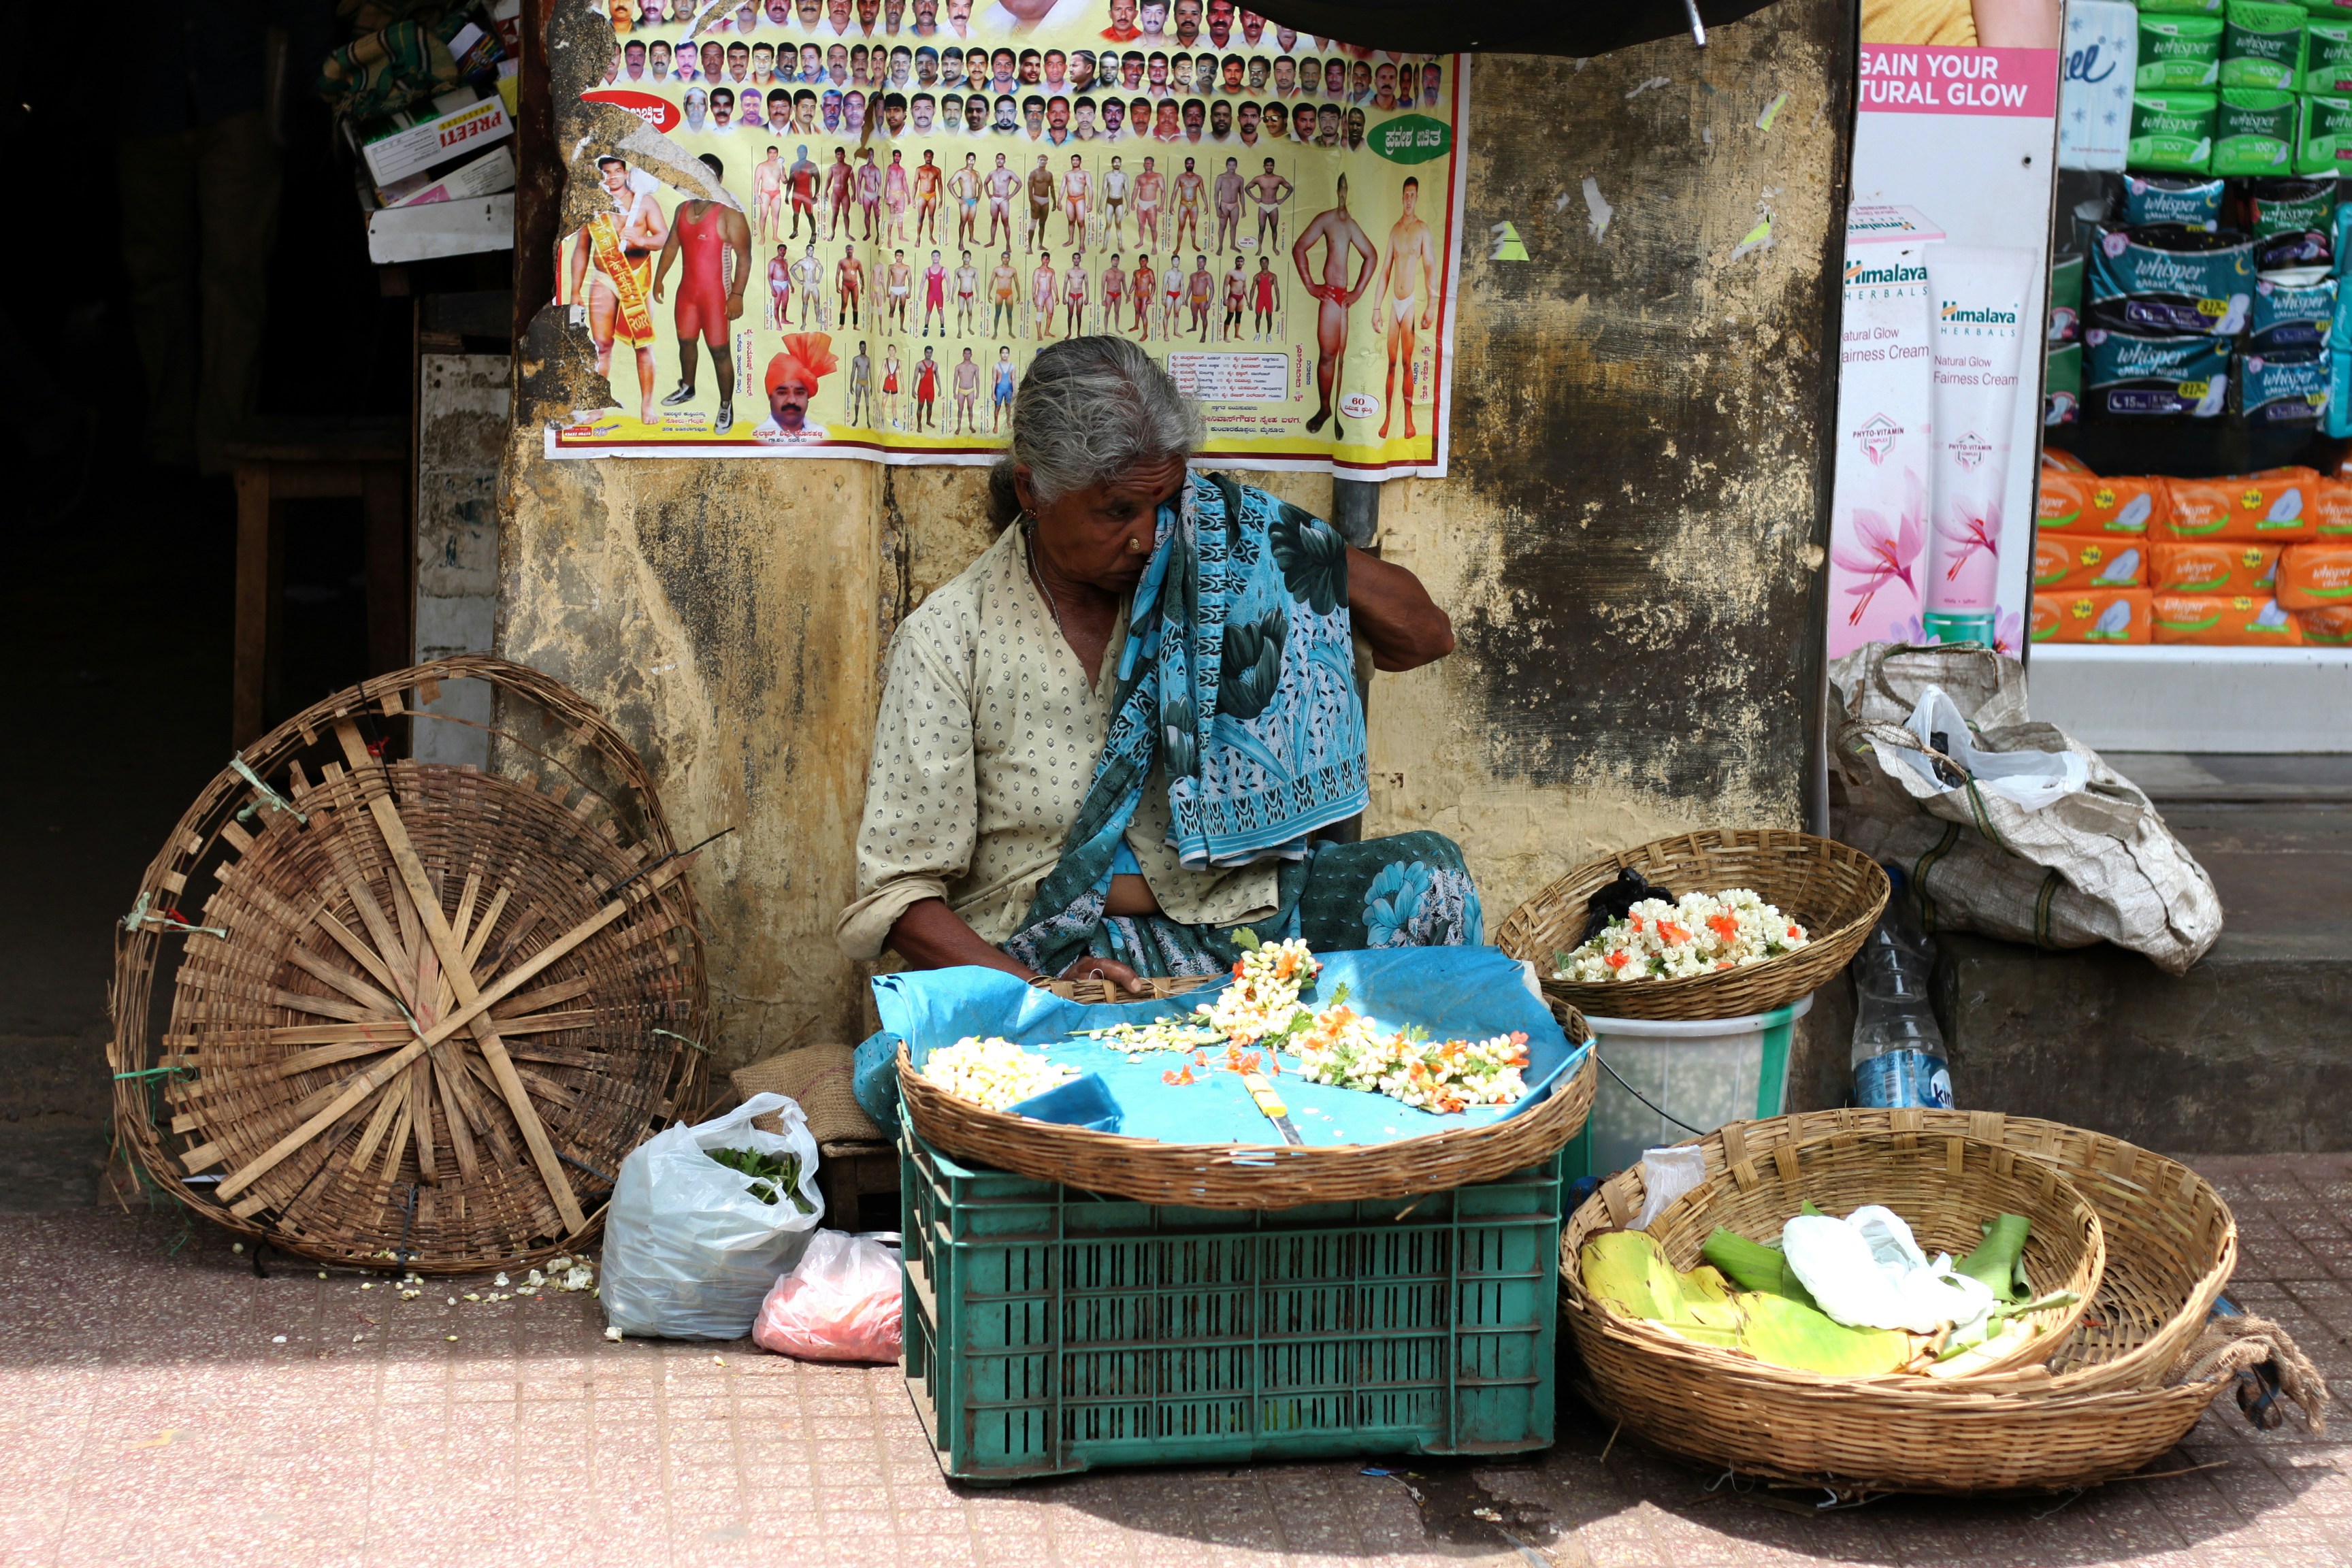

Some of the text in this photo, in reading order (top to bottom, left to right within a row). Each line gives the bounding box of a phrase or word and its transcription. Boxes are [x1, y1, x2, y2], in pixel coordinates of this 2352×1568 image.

[2153, 37, 2210, 58] whisper
[2236, 35, 2283, 54] whisper
[1861, 52, 1999, 80] GAIN YOUR
[1859, 80, 2028, 108] TURAL GLOW
[439, 110, 503, 148] PREETI
[2141, 113, 2198, 133] whisper
[2230, 111, 2276, 129] whisper
[1386, 126, 1414, 155] ಪ್ರವೇಶ
[2144, 193, 2198, 216] whisper
[1845, 260, 1928, 284] Himalaya
[2136, 255, 2204, 284] whisper
[1844, 287, 1928, 301] HERBALS
[2174, 282, 2208, 294] Nights
[1941, 300, 2016, 324] Himalaya
[2273, 292, 2325, 313] whisper
[1874, 327, 1899, 340] Glow
[1941, 327, 2015, 337] HERBALS
[1889, 344, 1929, 360] Cream
[1934, 355, 1992, 368] Natural Glow
[2117, 342, 2187, 371] whisper
[1933, 371, 2019, 386] Fairness Cream
[2156, 368, 2189, 378] Nights
[2264, 365, 2315, 390] whisper
[1352, 397, 1365, 406] 60
[2124, 397, 2136, 407] 15
[1853, 427, 1904, 438] PHYTO-VITAMIN
[1948, 443, 1993, 451] PHYTO-VITAMIN
[2251, 495, 2260, 503] 34
[2173, 502, 2214, 522] whisper
[2090, 552, 2099, 560] 34
[2176, 559, 2216, 578] whisper
[2313, 564, 2352, 583] whisper
[2081, 604, 2091, 612] 34
[2164, 598, 2206, 617] whisper
